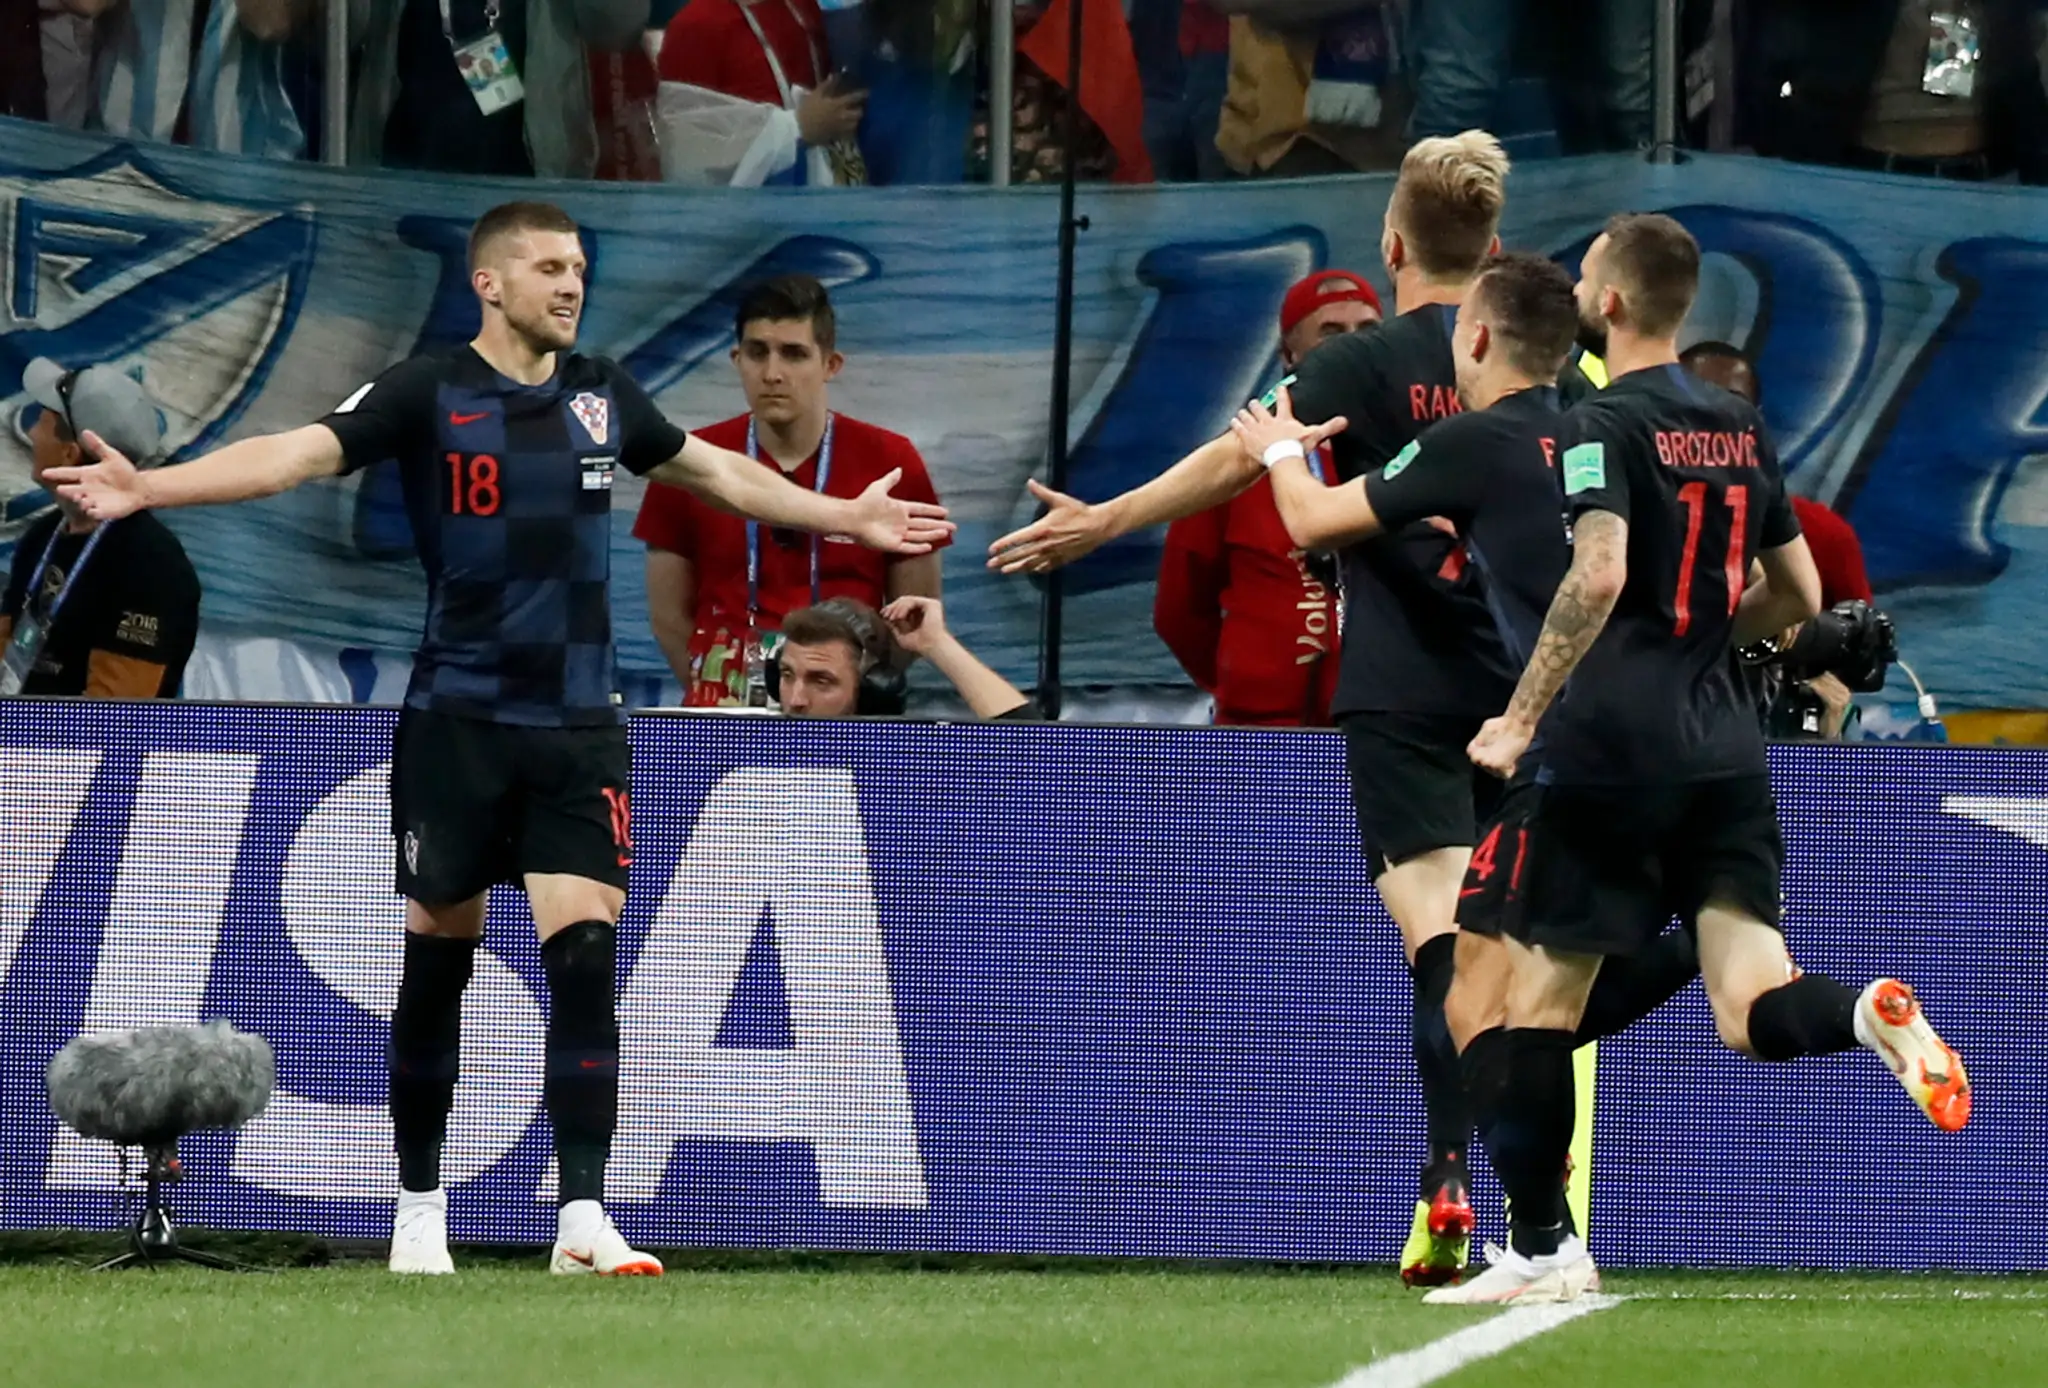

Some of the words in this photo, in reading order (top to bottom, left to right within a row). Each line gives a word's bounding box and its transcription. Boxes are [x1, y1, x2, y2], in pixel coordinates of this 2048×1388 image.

[1409, 384, 1463, 420] RAK
[446, 453, 500, 516] 18
[1673, 482, 1747, 637] 11
[120, 611, 159, 631] 2018
[1470, 822, 1504, 881] 4
